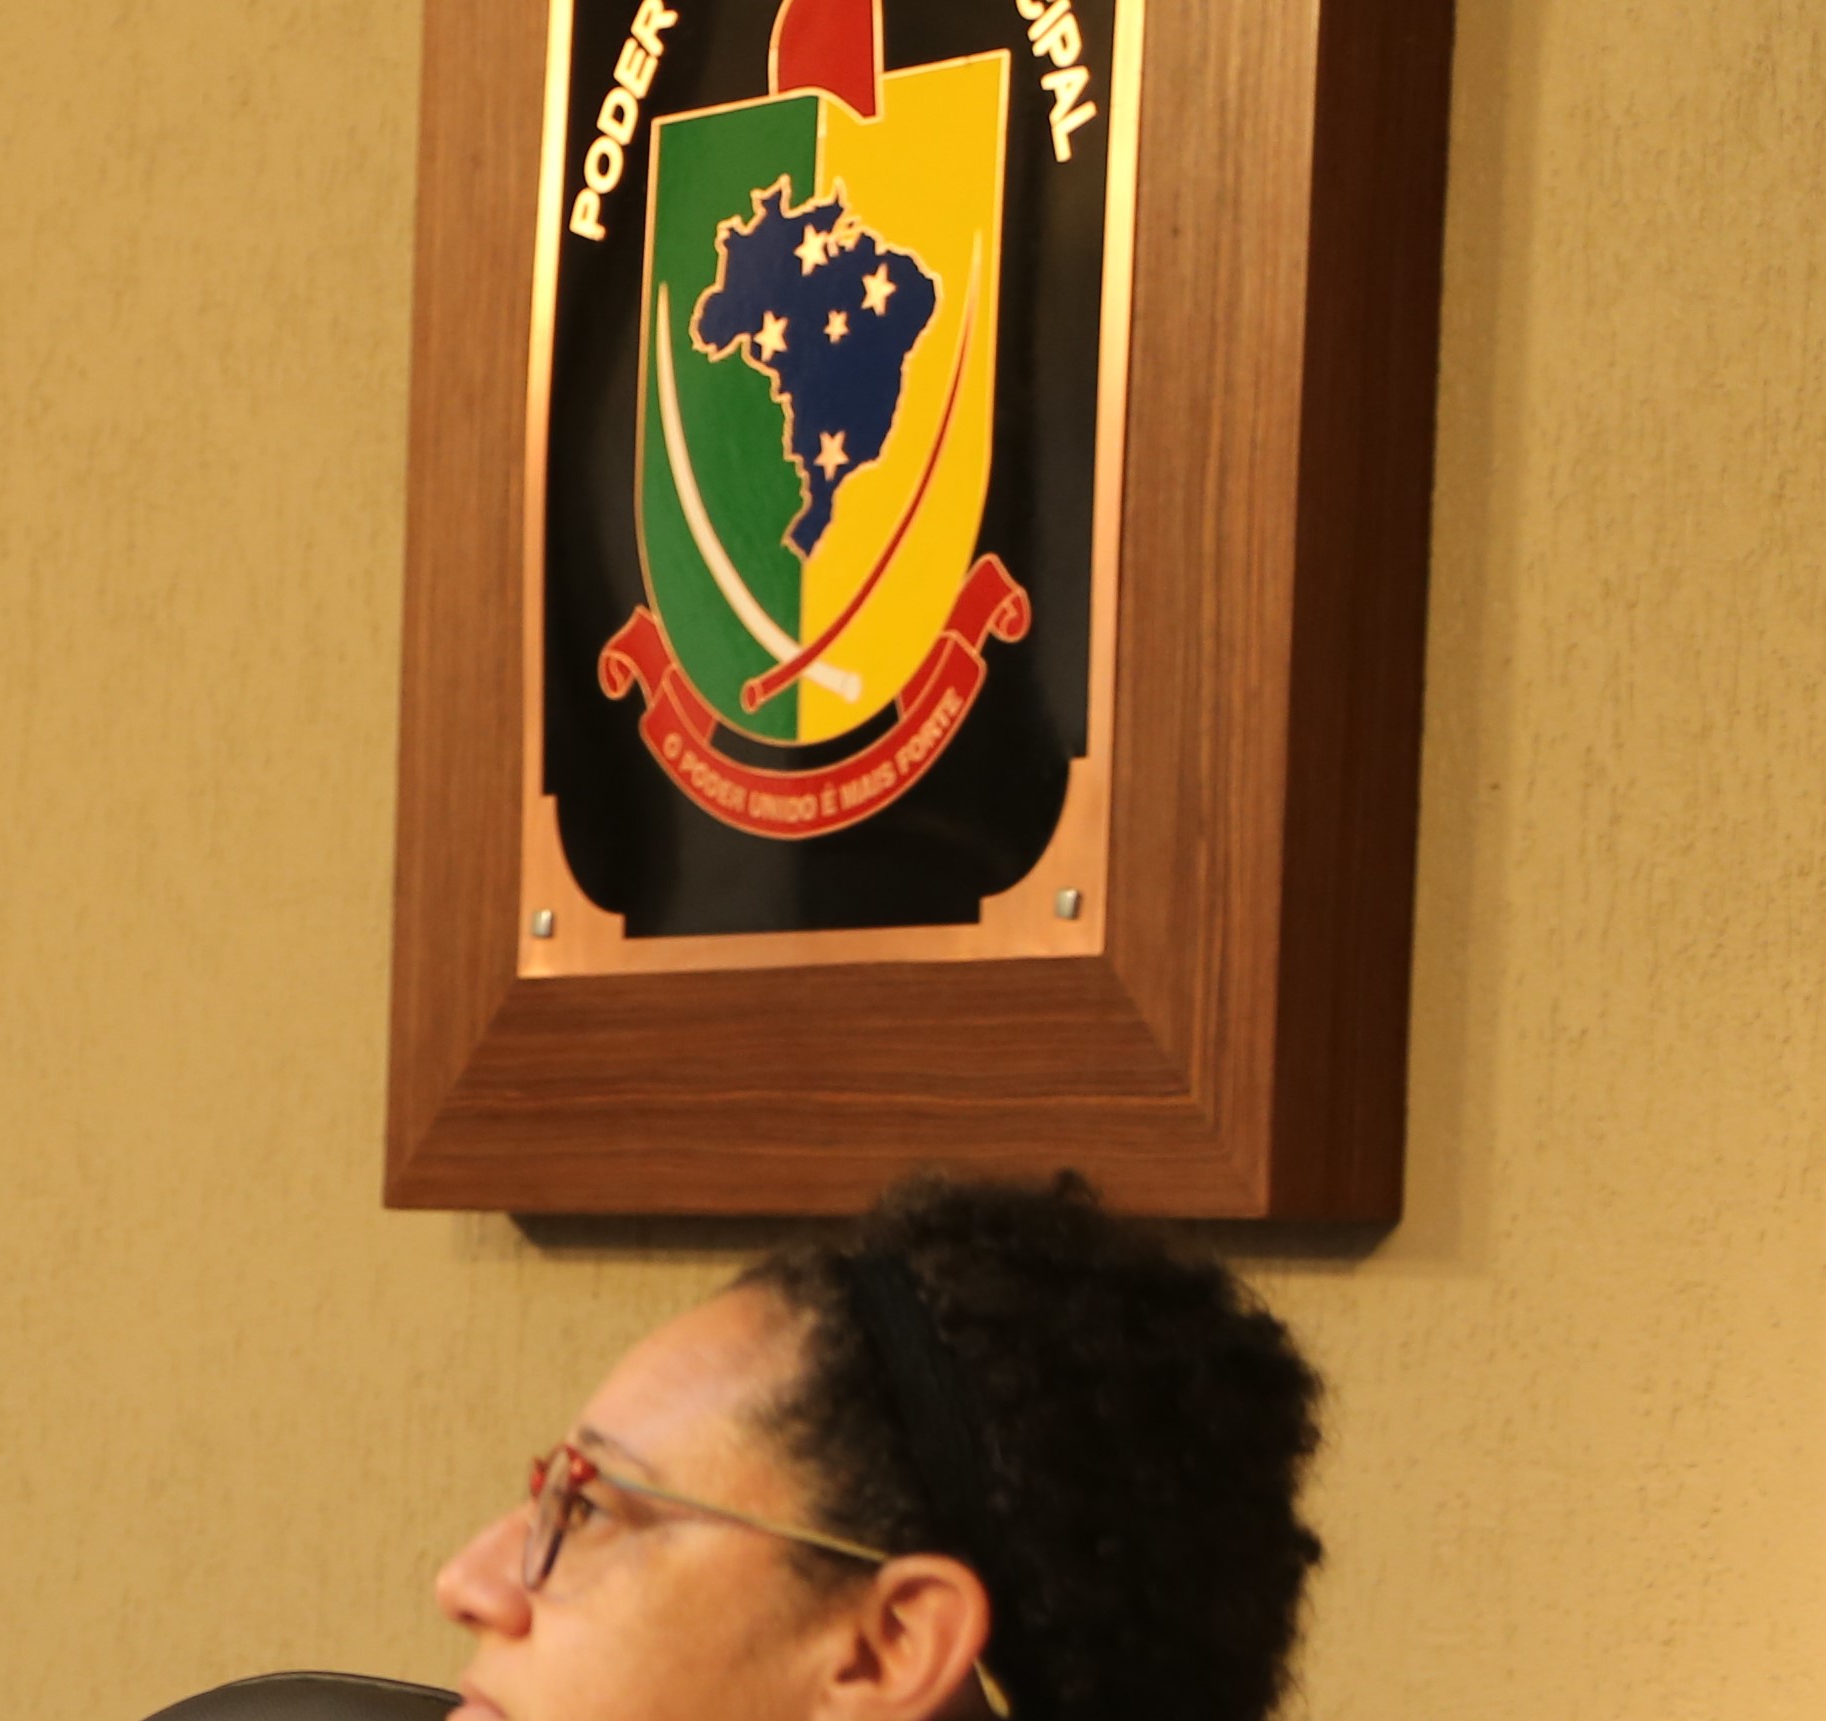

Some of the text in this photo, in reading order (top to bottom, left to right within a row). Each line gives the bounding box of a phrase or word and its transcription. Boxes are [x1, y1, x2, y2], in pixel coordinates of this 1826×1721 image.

[569, 0, 678, 241] PODER
[662, 686, 965, 823] O PODER UNIDO É MAIS FORTE
